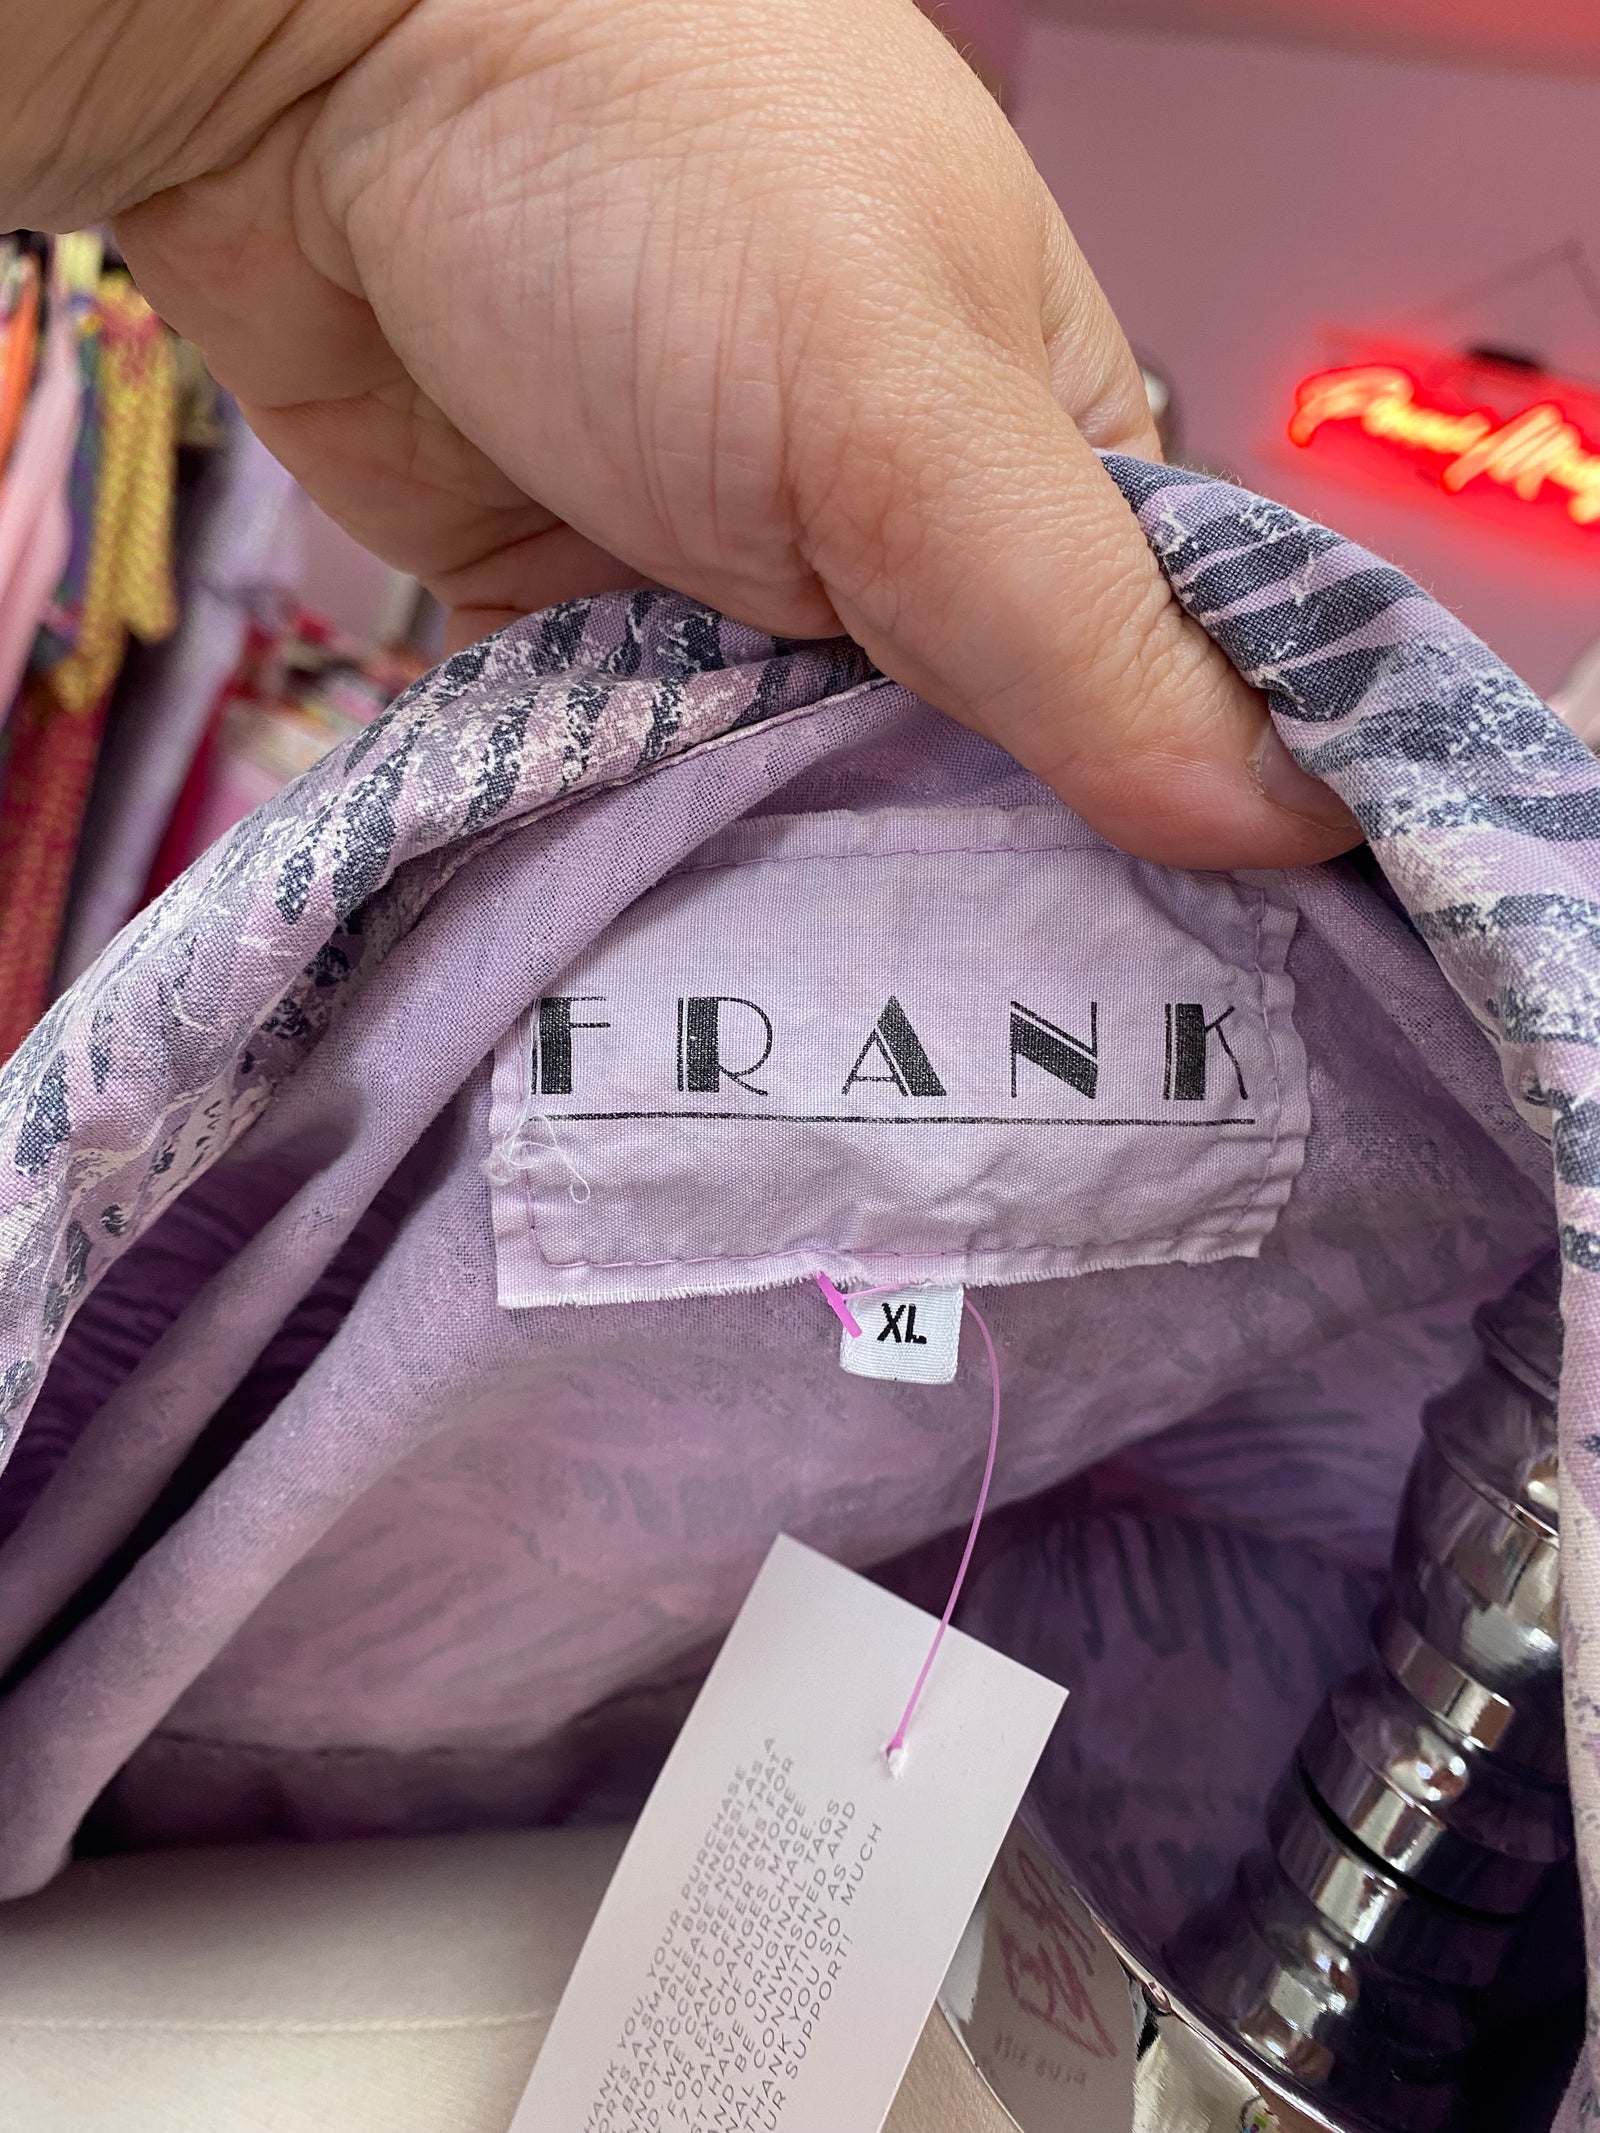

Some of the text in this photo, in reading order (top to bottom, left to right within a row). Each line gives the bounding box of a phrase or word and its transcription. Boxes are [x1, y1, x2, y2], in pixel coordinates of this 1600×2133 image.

[532, 996, 1248, 1101] FRANK
[877, 1302, 928, 1345] XL
[584, 1766, 746, 2133] HANK YOU, YOUR PURCHASE
[599, 2065, 631, 2133] ORTS
[631, 2041, 644, 2059] A
[641, 1947, 683, 2031] SMALL
[745, 1759, 764, 1795] AS
[763, 1737, 776, 1755] A
[622, 1752, 780, 2115] BRAND. PLEASE NOTE THAT
[661, 2045, 685, 2088] WE
[685, 1977, 712, 2036] CAN
[713, 1881, 755, 1967] OFFER
[754, 1787, 796, 1872] STORE
[663, 1945, 708, 2056] ACCEPT
[709, 1817, 767, 1940] RETURNS
[766, 1758, 794, 1810] FOR
[667, 1801, 806, 2118] FOR EXCHANGES MADE
[679, 1821, 816, 2126] 7 DAYS OF PURCHASE.
[708, 2020, 744, 2097] HAVE
[745, 1881, 807, 2008] ORIGINAL
[804, 1800, 839, 1864] TAGS
[733, 2032, 756, 2074] BE
[754, 1868, 826, 2023] UNWASHED
[827, 1802, 855, 1860] AND
[744, 1823, 881, 2132] THANK YOU SO MUCH
[752, 1909, 827, 2069] CONDITION
[827, 1863, 847, 1902] AS
[763, 1934, 852, 2132] UR SUPPORT!
